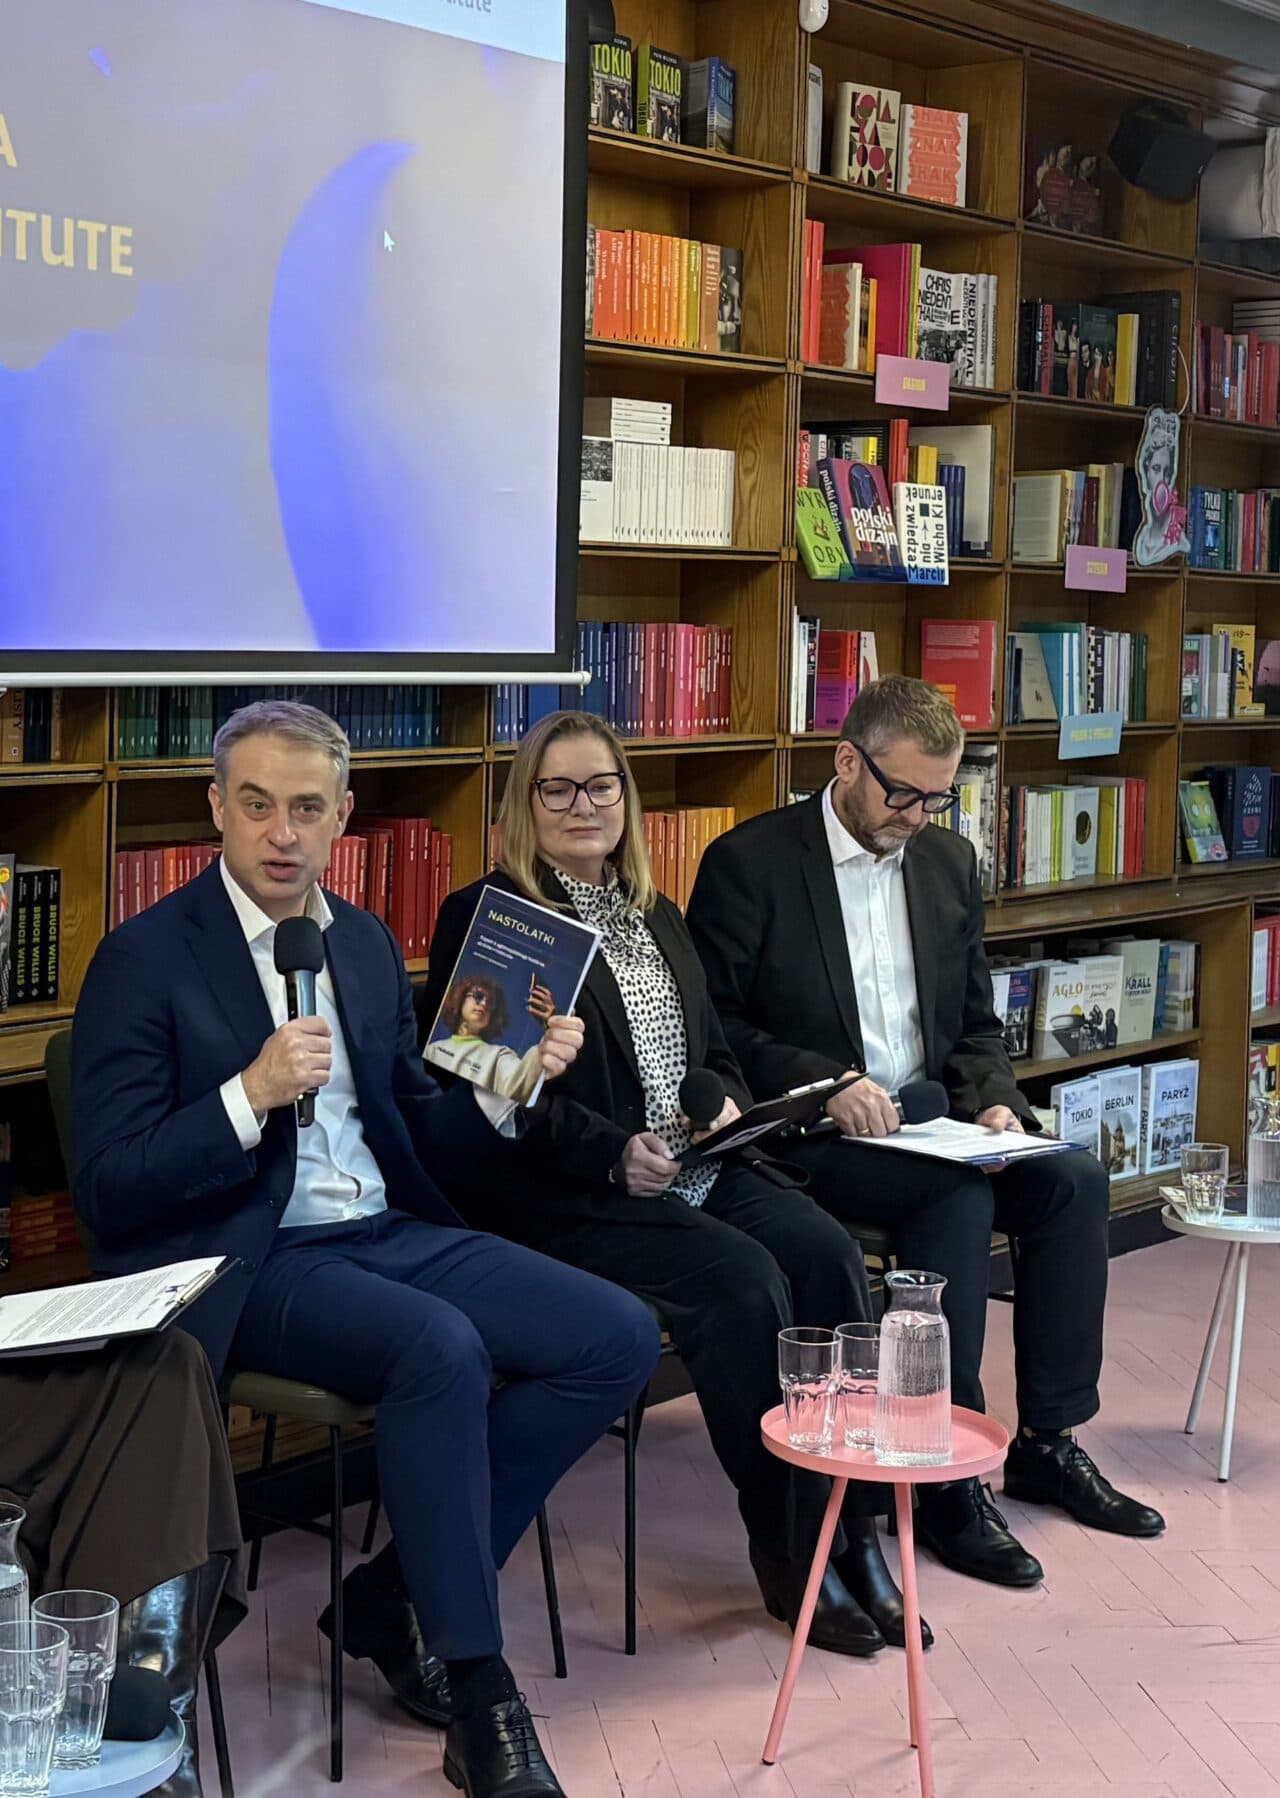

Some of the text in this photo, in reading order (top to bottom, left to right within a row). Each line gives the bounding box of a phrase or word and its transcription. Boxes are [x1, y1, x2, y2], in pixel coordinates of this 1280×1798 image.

[594, 44, 632, 79] TOKIO
[650, 59, 681, 97] TOKIO
[925, 273, 952, 295] CHRIS
[966, 282, 978, 379] NIEDENTHAL
[820, 469, 835, 503] polski
[850, 505, 893, 531] polski
[812, 543, 849, 564] OBY
[855, 526, 899, 550] dizajn
[31, 905, 41, 984] BRUCE WILLIS
[47, 903, 57, 982] BRUCE WILLIS
[488, 909, 556, 946] NASTOLATKI
[17, 906, 26, 985] BRUCE WILLIS
[1124, 975, 1152, 989] KRALL
[1071, 1108, 1093, 1124] TOKIO
[1105, 1094, 1135, 1111] BERLIN
